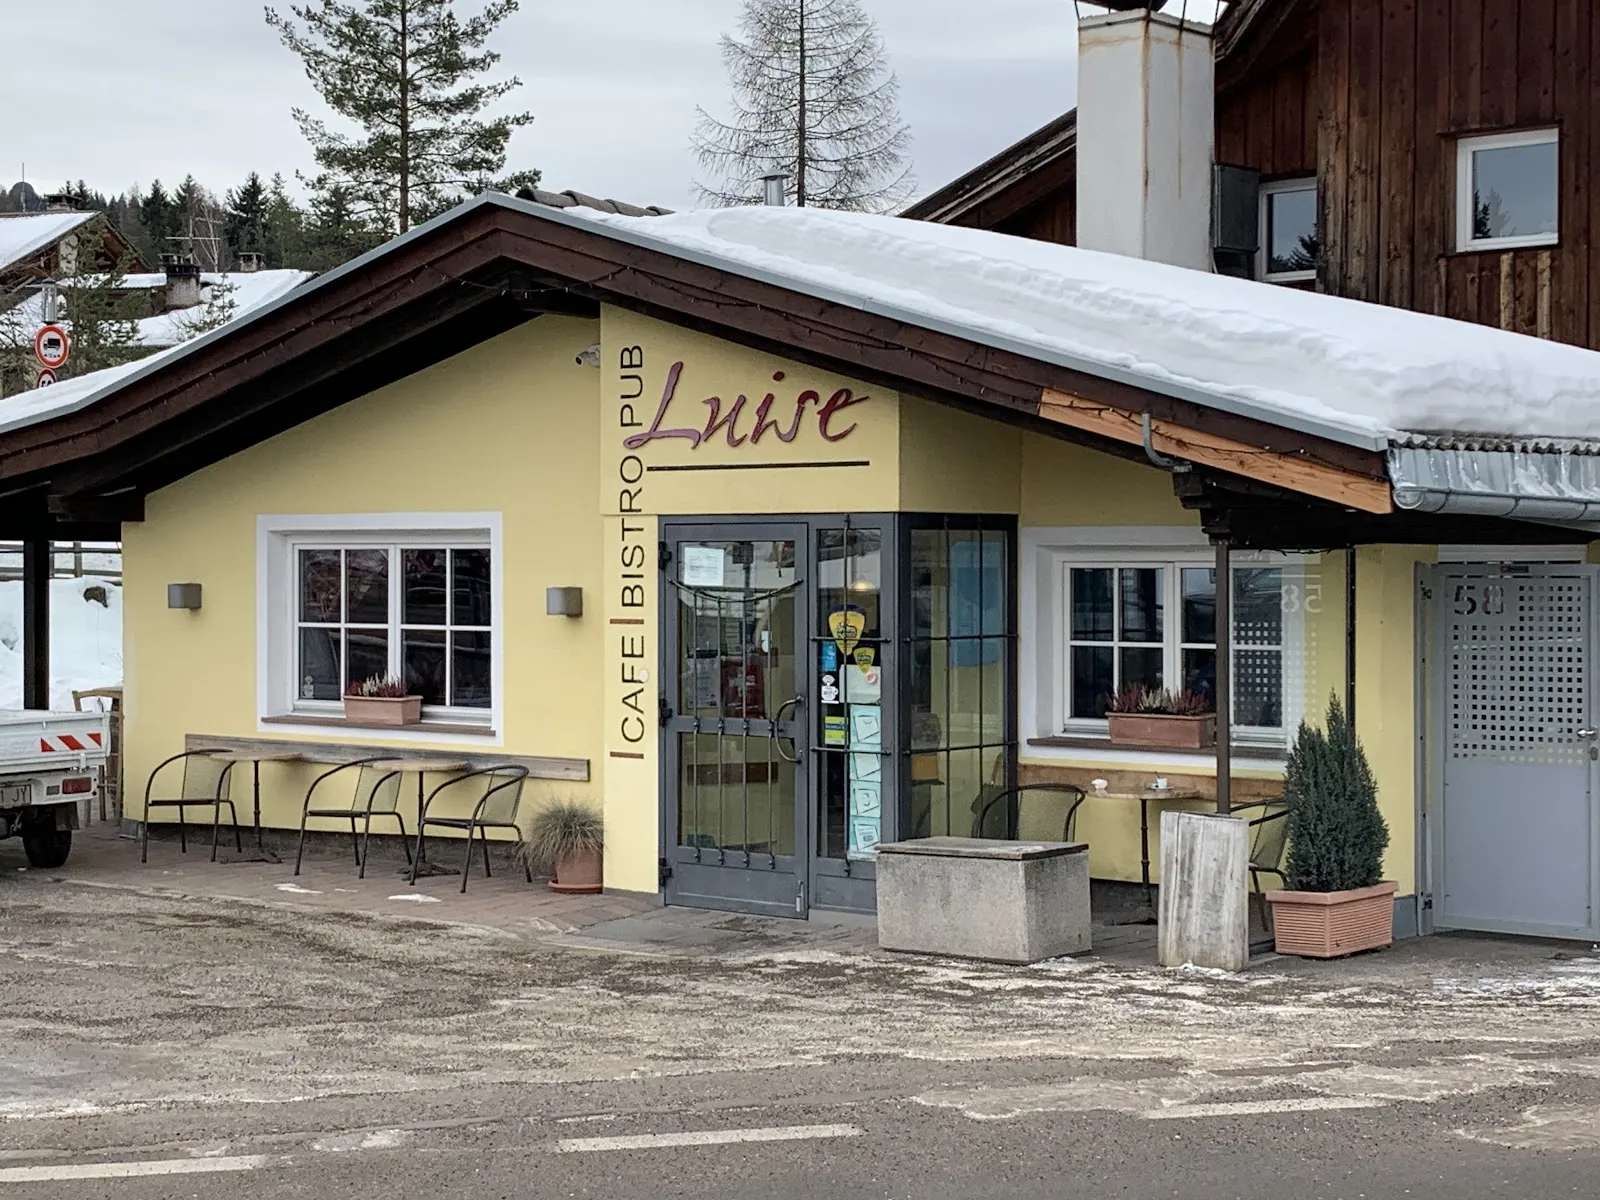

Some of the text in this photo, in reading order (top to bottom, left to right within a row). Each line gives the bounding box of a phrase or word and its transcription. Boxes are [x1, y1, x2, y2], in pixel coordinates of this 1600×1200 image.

[623, 361, 869, 450] Luise
[620, 345, 645, 743] CAFE BISTRO PUB
[1454, 584, 1504, 615] 58
